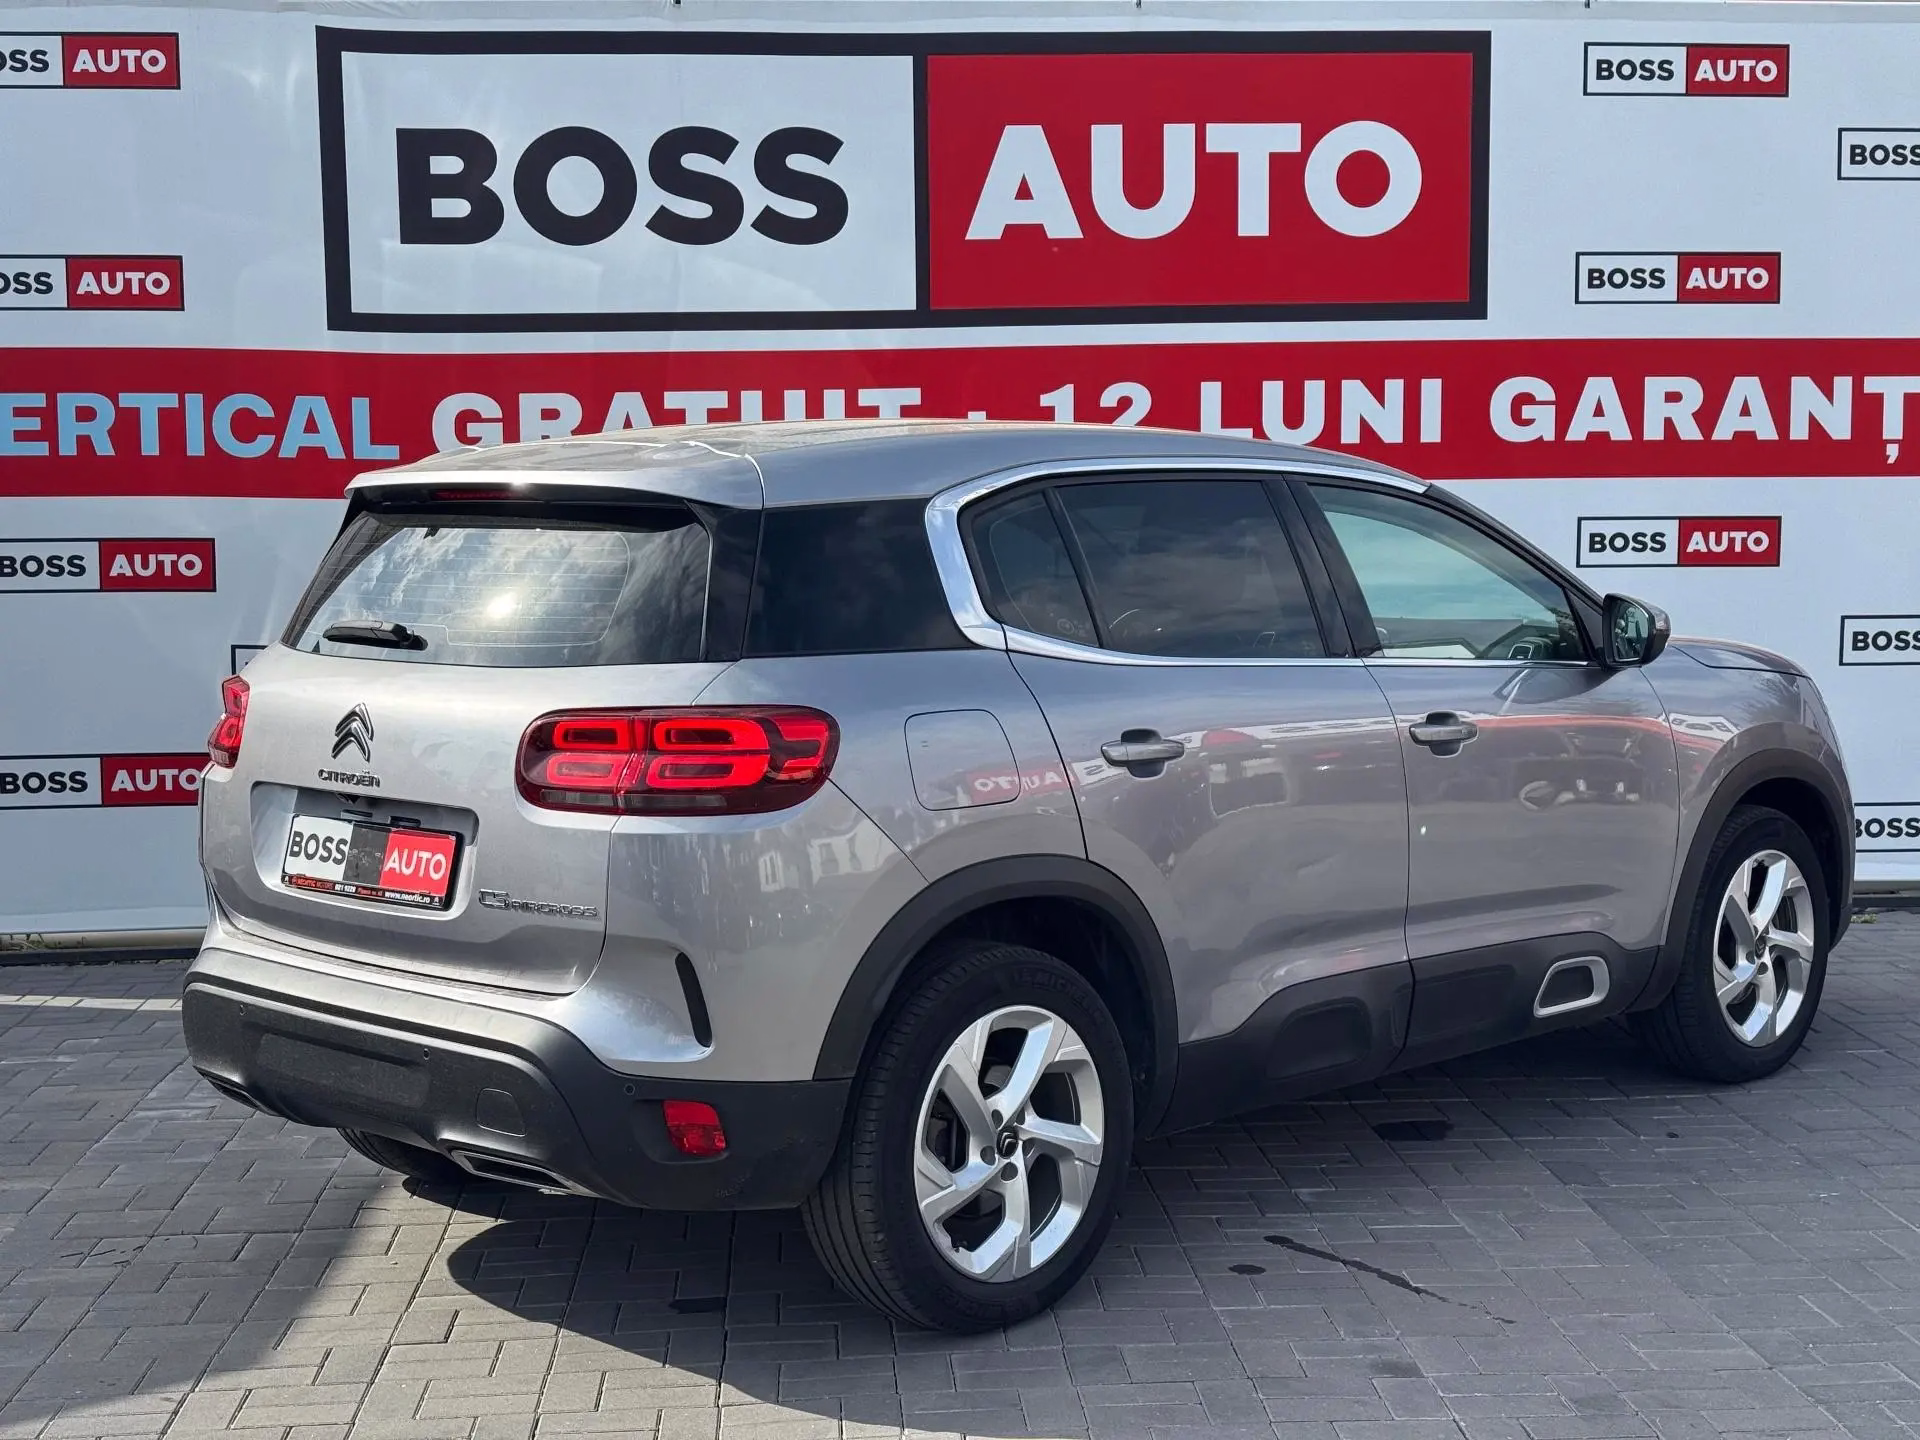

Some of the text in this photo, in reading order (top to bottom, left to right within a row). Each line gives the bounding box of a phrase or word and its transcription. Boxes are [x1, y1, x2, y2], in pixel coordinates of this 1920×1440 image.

[73, 49, 166, 73] AUTO
[1595, 59, 1778, 82] BOSS AUTO
[396, 121, 1422, 246] BOSS AUTO
[77, 272, 170, 295] AUTO
[1587, 267, 1769, 289] BOSS AUTO
[0, 392, 400, 460] ERTICAL
[1039, 381, 1152, 427] 12
[1200, 379, 1442, 446] LUNI
[1489, 375, 1920, 464] GARANȚ
[1588, 531, 1770, 553] BOSS AUTO
[0, 554, 203, 577] BOSS AUTO
[0, 769, 199, 794] BOSS AUTO
[289, 831, 447, 881] BOSS AUTO
